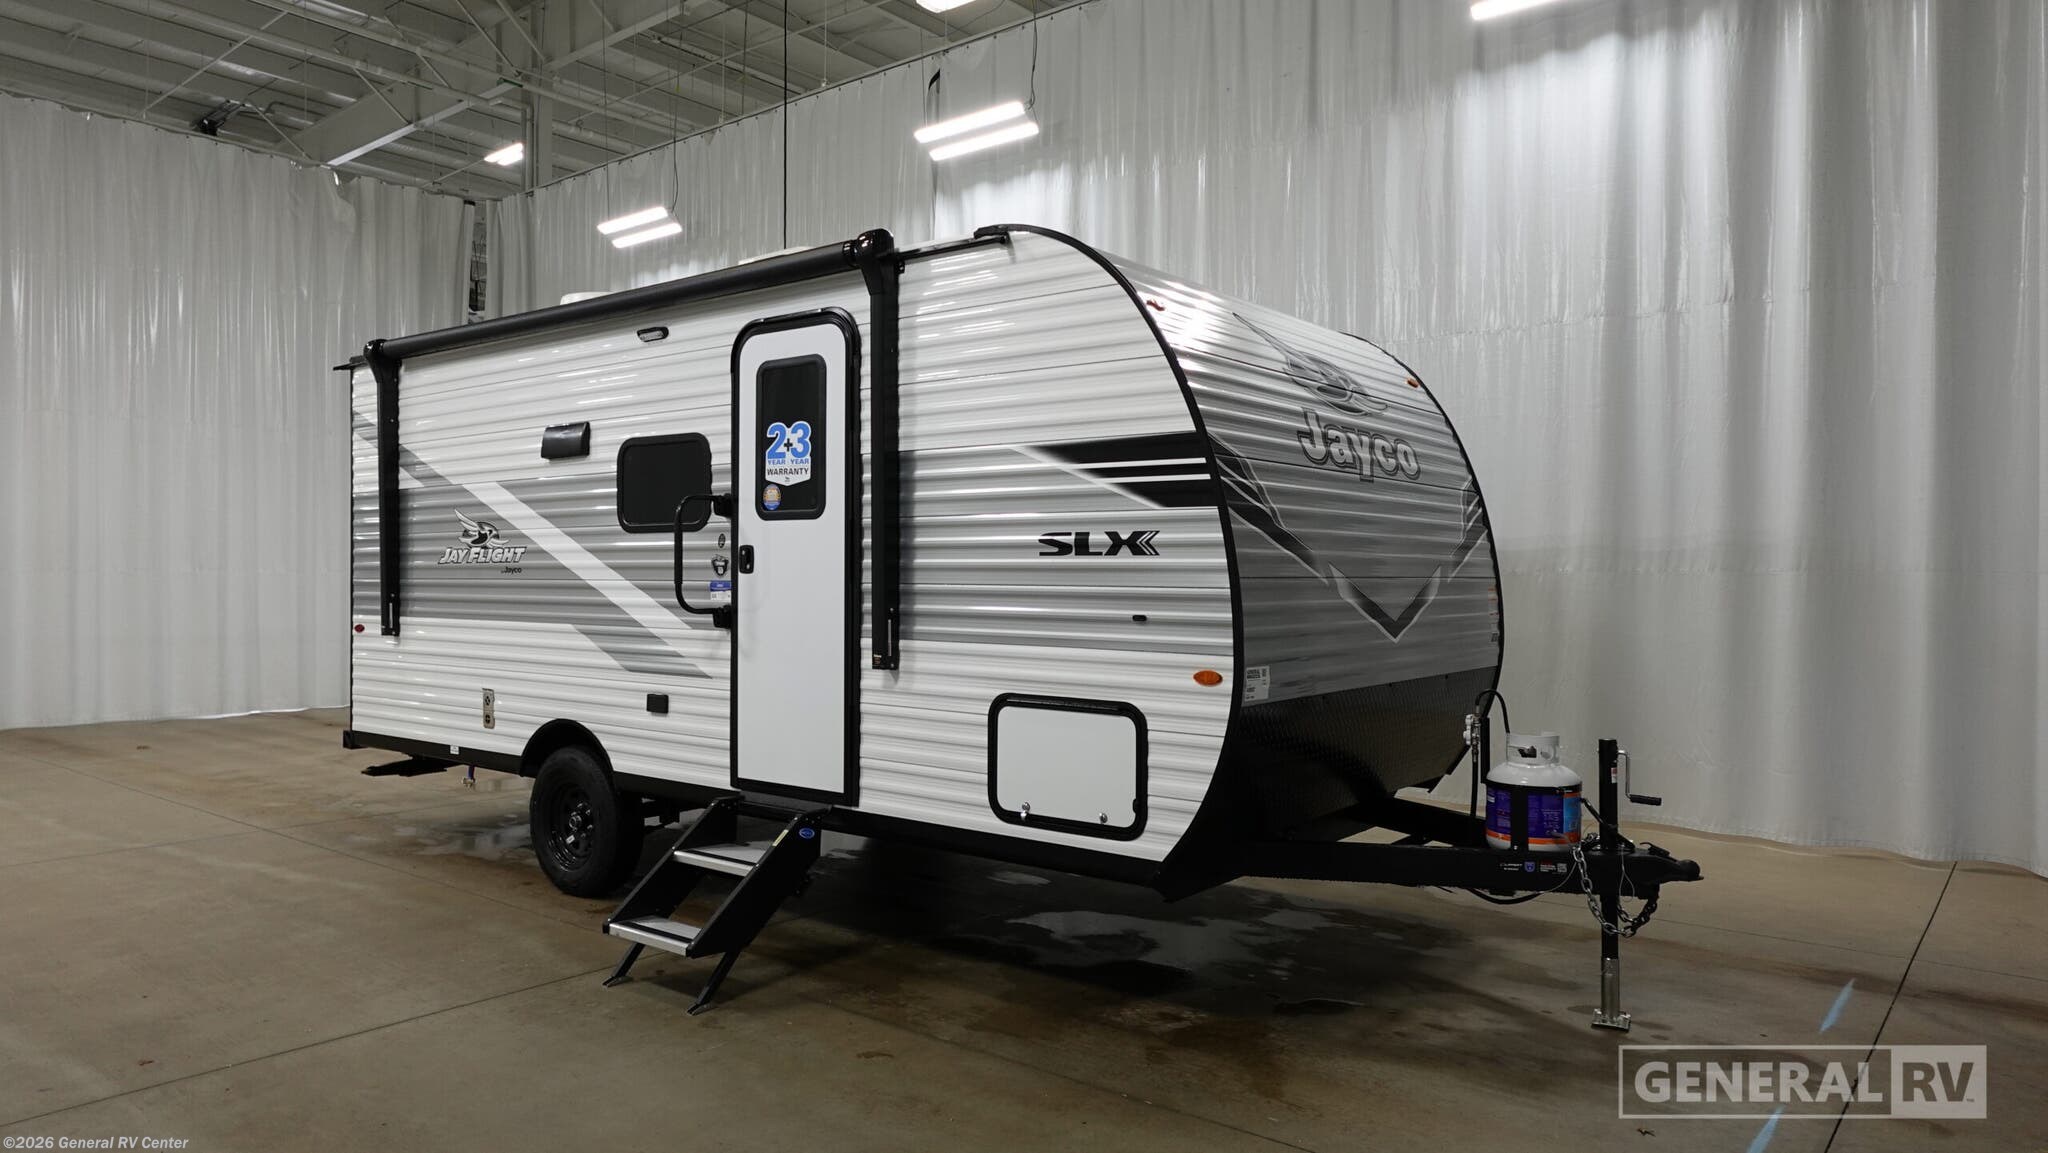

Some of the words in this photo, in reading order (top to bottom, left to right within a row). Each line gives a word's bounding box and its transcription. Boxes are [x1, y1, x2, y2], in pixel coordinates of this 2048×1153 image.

[1297, 407, 1421, 482] Jayco
[766, 467, 809, 476] WARRANTY
[1038, 531, 1160, 556] SLX
[438, 547, 470, 564] JAY
[466, 546, 527, 563] FLIGHT
